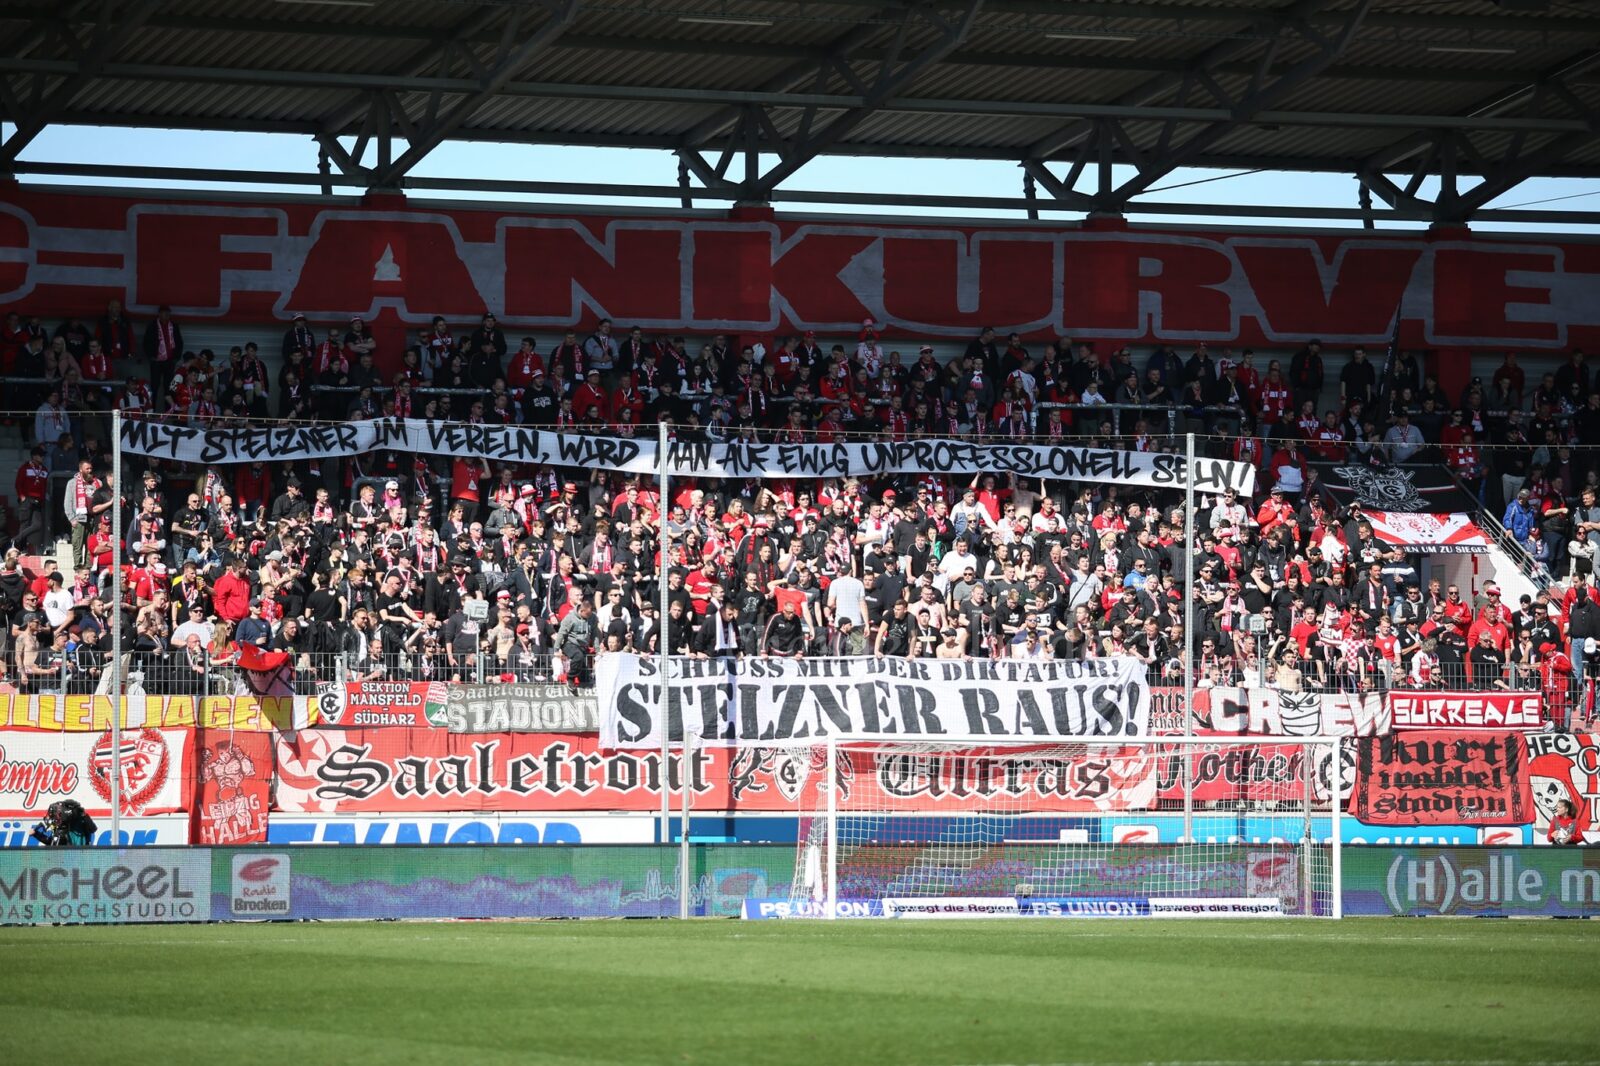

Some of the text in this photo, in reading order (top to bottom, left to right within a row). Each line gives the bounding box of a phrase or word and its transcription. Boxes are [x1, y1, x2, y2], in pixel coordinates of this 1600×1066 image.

[200, 423, 358, 464] STELZNER
[653, 440, 713, 471] MAN
[716, 443, 770, 473] AUF
[777, 443, 852, 477] EWIG
[1421, 545, 1437, 554] UM
[1439, 545, 1453, 554] ZU
[1455, 546, 1491, 555] SIEGEN
[638, 657, 1120, 682] SCHLUSS MIT DER DIKTATUR!
[309, 681, 338, 699] HFC
[361, 682, 410, 692] SEKTION
[350, 693, 422, 707] MANSFELD
[0, 694, 127, 730] LLEN
[139, 694, 294, 731] JAGEN
[353, 711, 416, 725] SÜDHARZ
[616, 680, 1141, 743] STELZNER RAUS!
[1394, 698, 1540, 725] SURREALE
[1526, 734, 1572, 758] HFC
[0, 744, 79, 810] empre
[314, 739, 714, 800] Saalefront
[201, 811, 267, 845] HALLE
[1386, 854, 1545, 914] (H)alle
[43, 902, 195, 920] KOCHSTUDIO
[234, 899, 287, 911] Brocken
[760, 900, 872, 917] PS UNON
[942, 903, 964, 913] die
[968, 903, 1015, 916] Region
[1033, 901, 1139, 916] PS UNION
[1153, 903, 1279, 915] bewegt die Region
